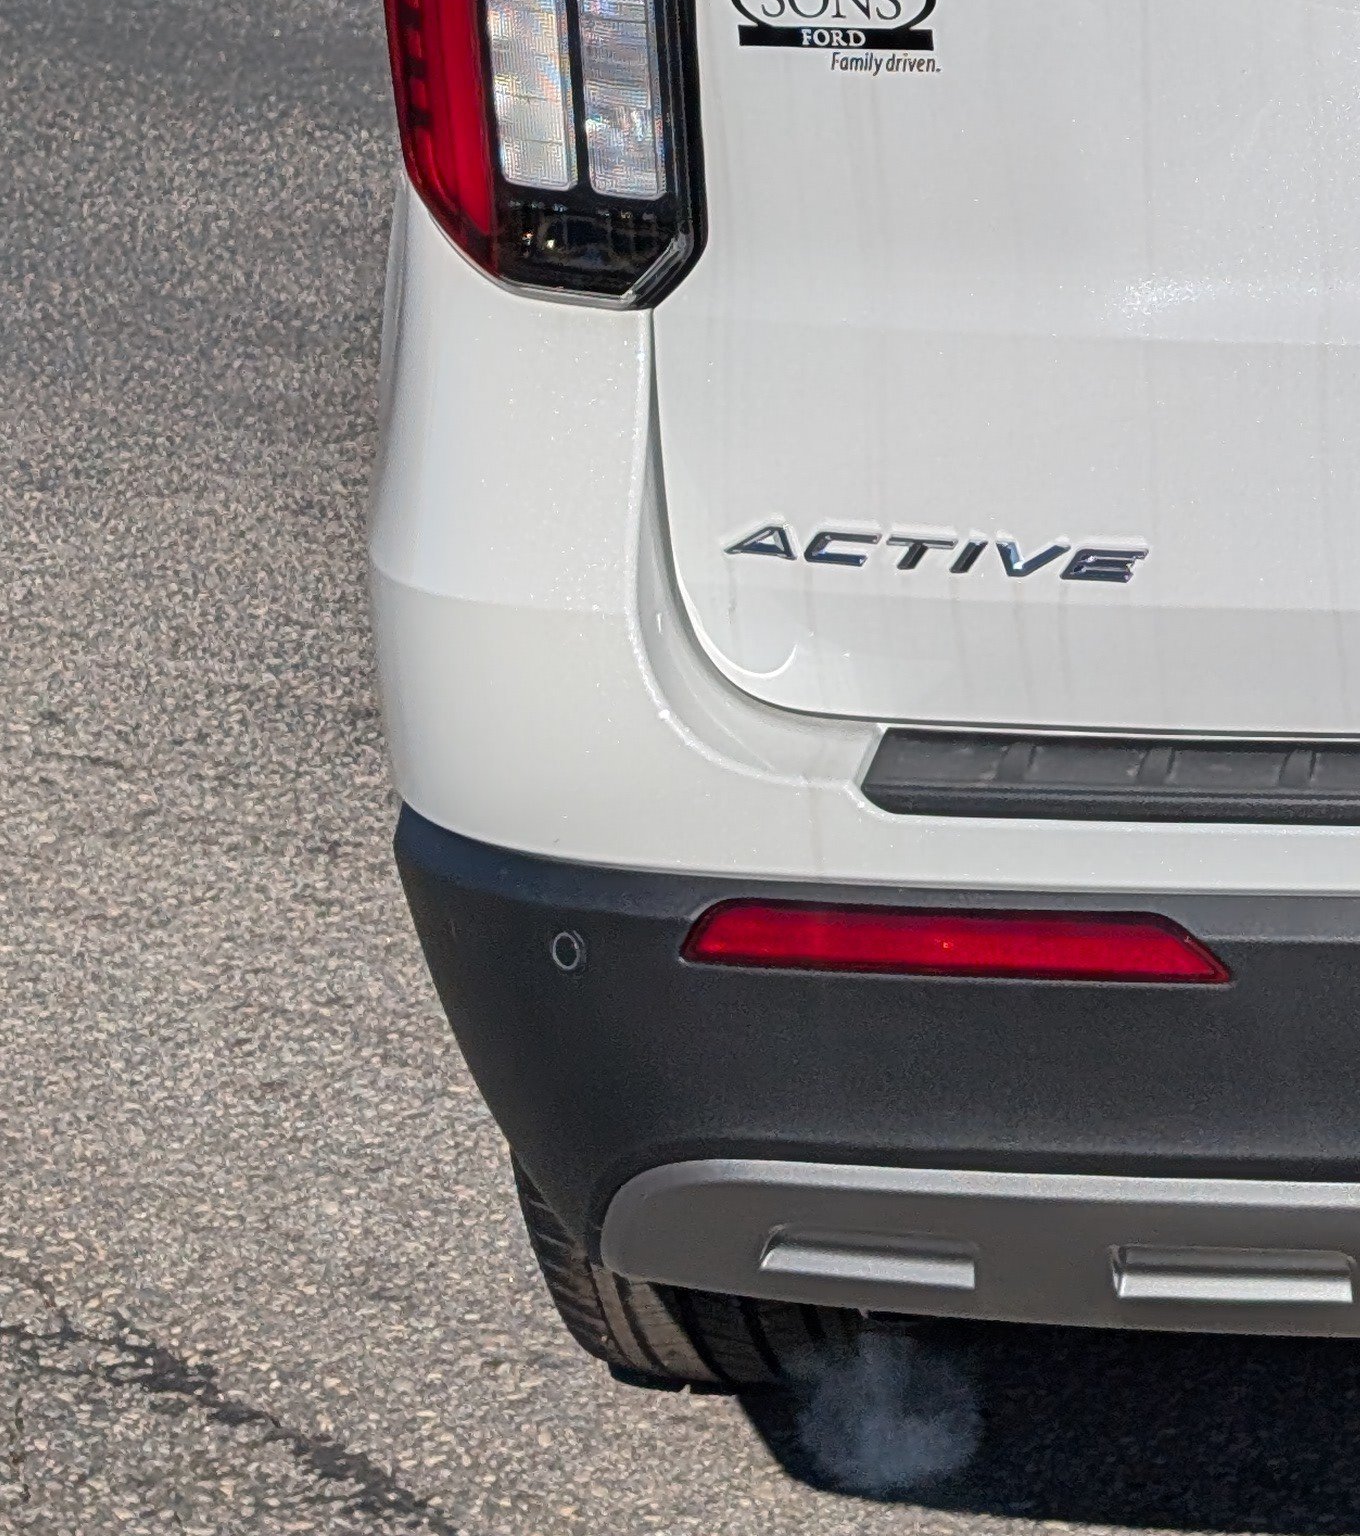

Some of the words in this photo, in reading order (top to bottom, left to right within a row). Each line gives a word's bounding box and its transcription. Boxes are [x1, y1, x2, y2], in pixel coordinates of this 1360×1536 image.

[800, 27, 867, 48] FORD
[830, 51, 884, 77] Family
[885, 52, 942, 74] driven.
[722, 519, 1151, 584] ACTIVE
